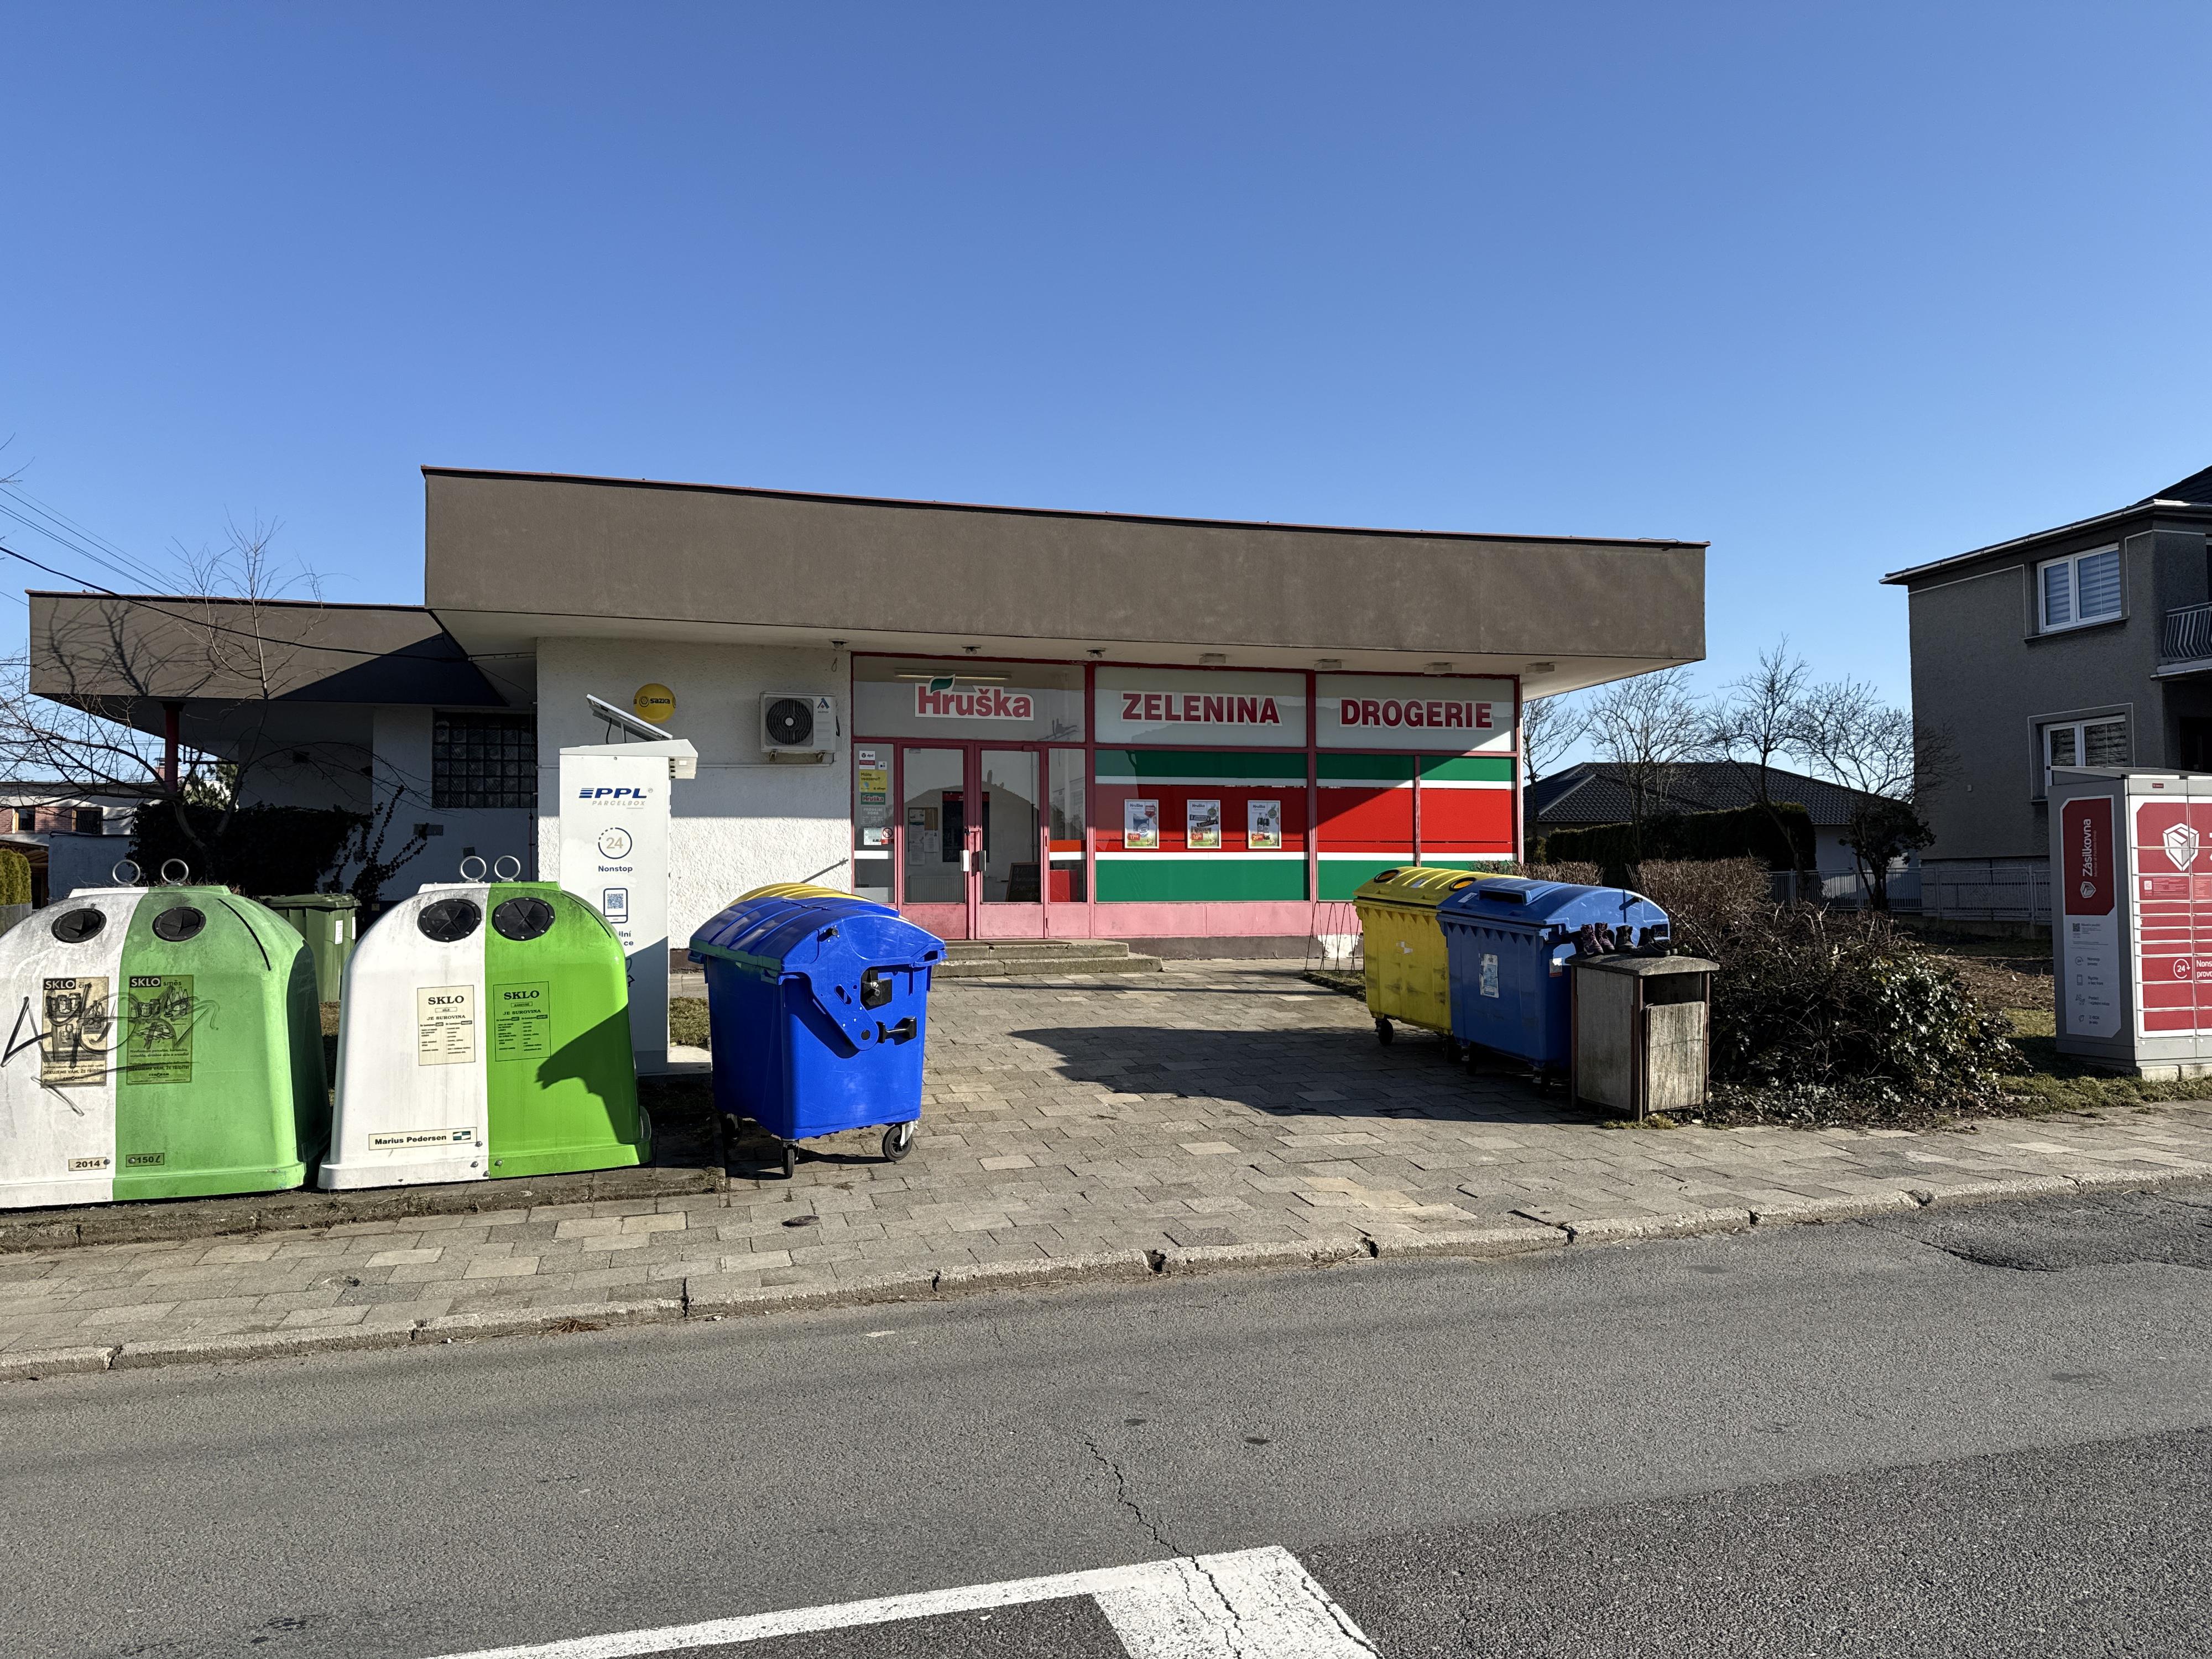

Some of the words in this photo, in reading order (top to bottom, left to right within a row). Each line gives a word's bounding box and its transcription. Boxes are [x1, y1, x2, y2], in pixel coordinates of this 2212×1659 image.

[919, 686, 1031, 718] Hruška
[1123, 693, 1280, 723] ZELENINA
[1342, 700, 1492, 728] DROGERIE
[594, 788, 647, 799] PPL
[606, 837, 623, 849] 24
[2082, 818, 2093, 877] Zásilkovna
[45, 980, 75, 989] SKLO
[131, 978, 160, 987] SKLO
[428, 995, 464, 1005] SKLO
[504, 990, 540, 1000] SKLO
